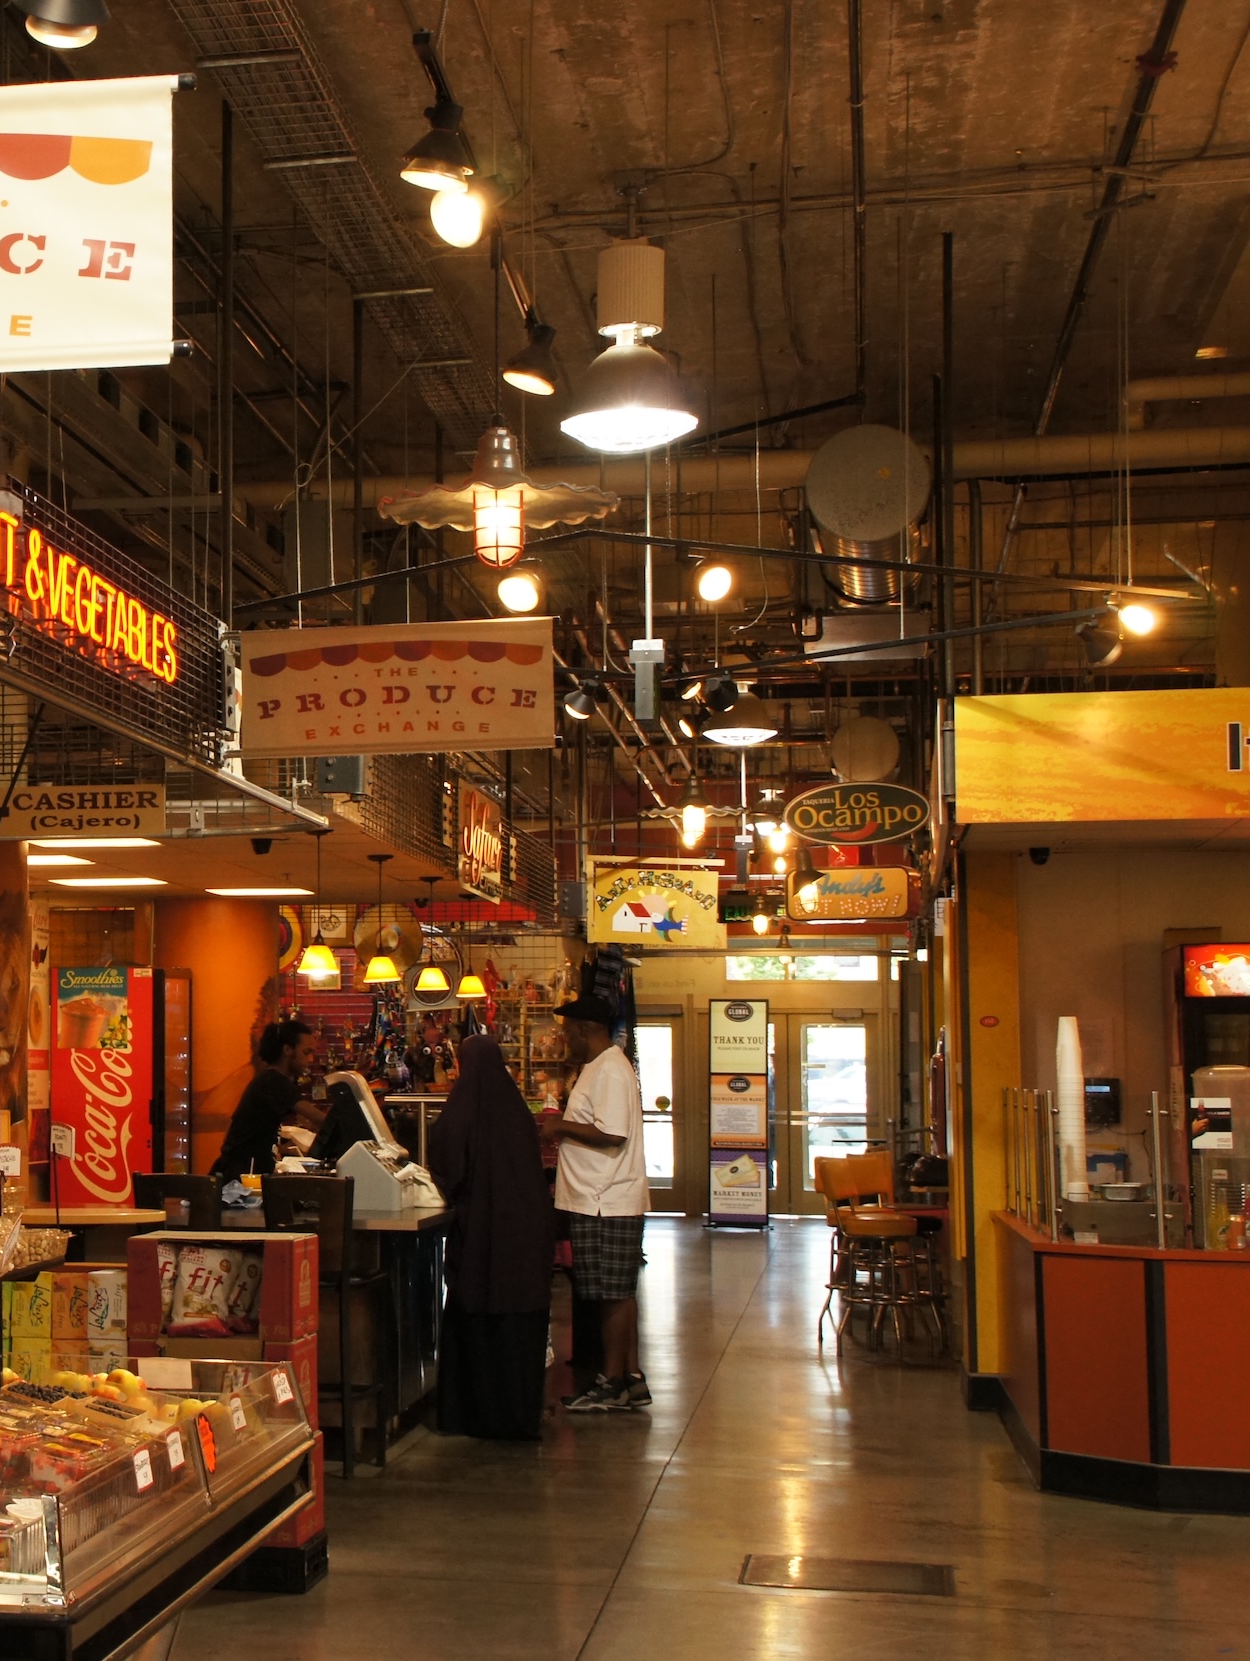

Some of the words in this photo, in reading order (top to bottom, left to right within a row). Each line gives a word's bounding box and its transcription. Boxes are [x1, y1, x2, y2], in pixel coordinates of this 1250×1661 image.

[25, 528, 44, 601] &
[47, 545, 178, 683] VEGETABLES
[374, 667, 418, 678] THE
[257, 685, 538, 719] PRODUCE
[305, 720, 491, 740] EXCHANGE
[12, 790, 159, 811] CASHIER
[802, 798, 835, 806] TAQUERIA
[834, 790, 880, 809] Los
[30, 813, 141, 831] (Cajero)
[793, 804, 922, 830] Ocampo
[794, 898, 833, 916] ET
[60, 968, 124, 988] Smoothies
[713, 1035, 745, 1044] THANK
[746, 1035, 765, 1045] YOU
[71, 1014, 133, 1203] Coca-Co
[187, 1267, 224, 1300] fit
